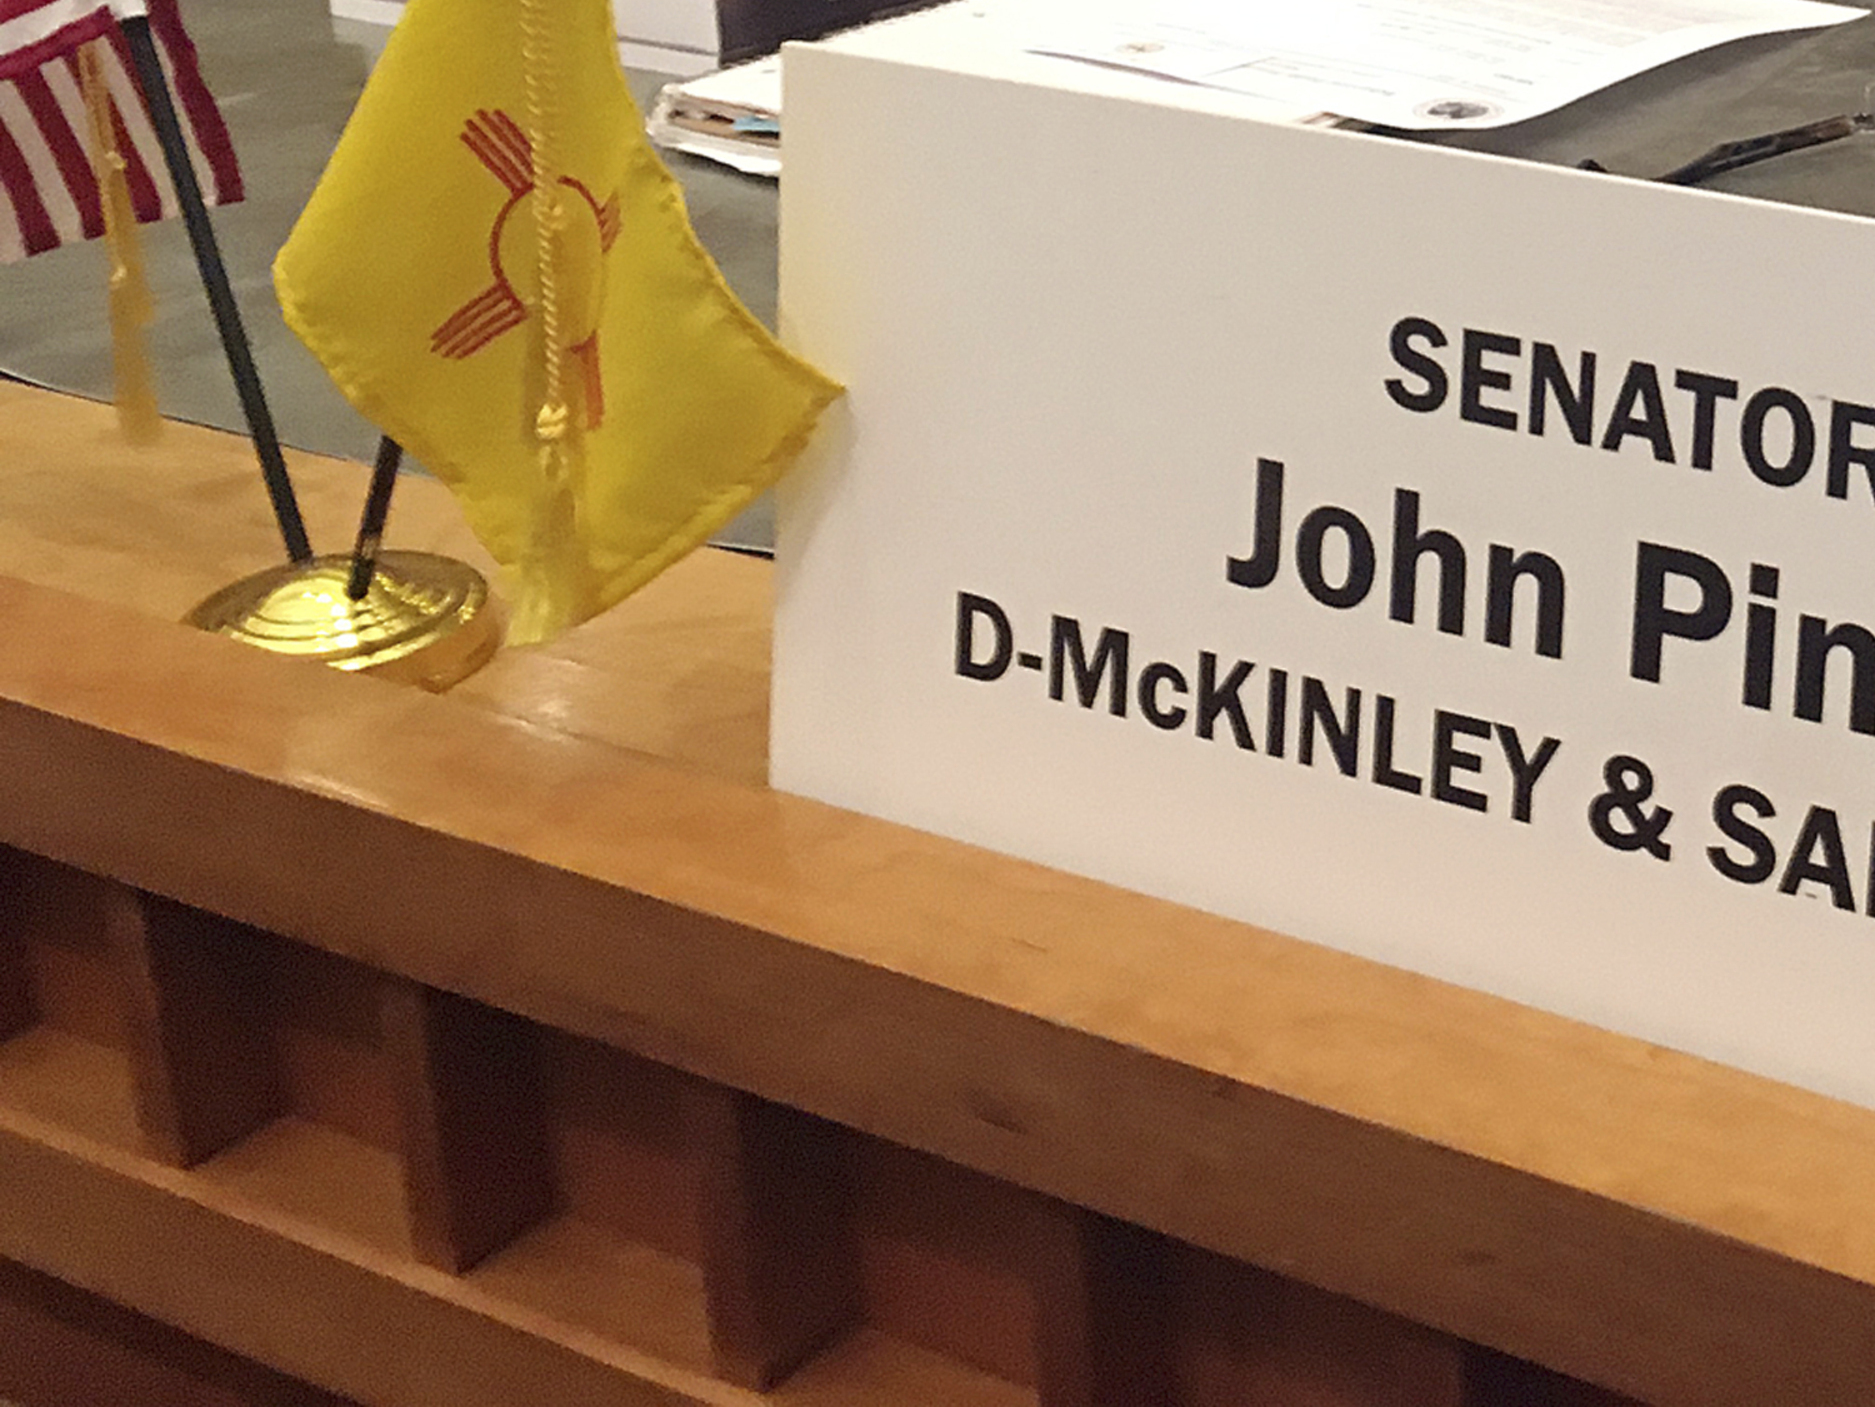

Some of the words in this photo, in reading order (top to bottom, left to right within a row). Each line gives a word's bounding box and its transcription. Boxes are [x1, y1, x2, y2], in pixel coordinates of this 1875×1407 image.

[1225, 456, 1566, 661] John
[954, 590, 1563, 825] D-McKINLEY
[1587, 754, 1675, 863] &
